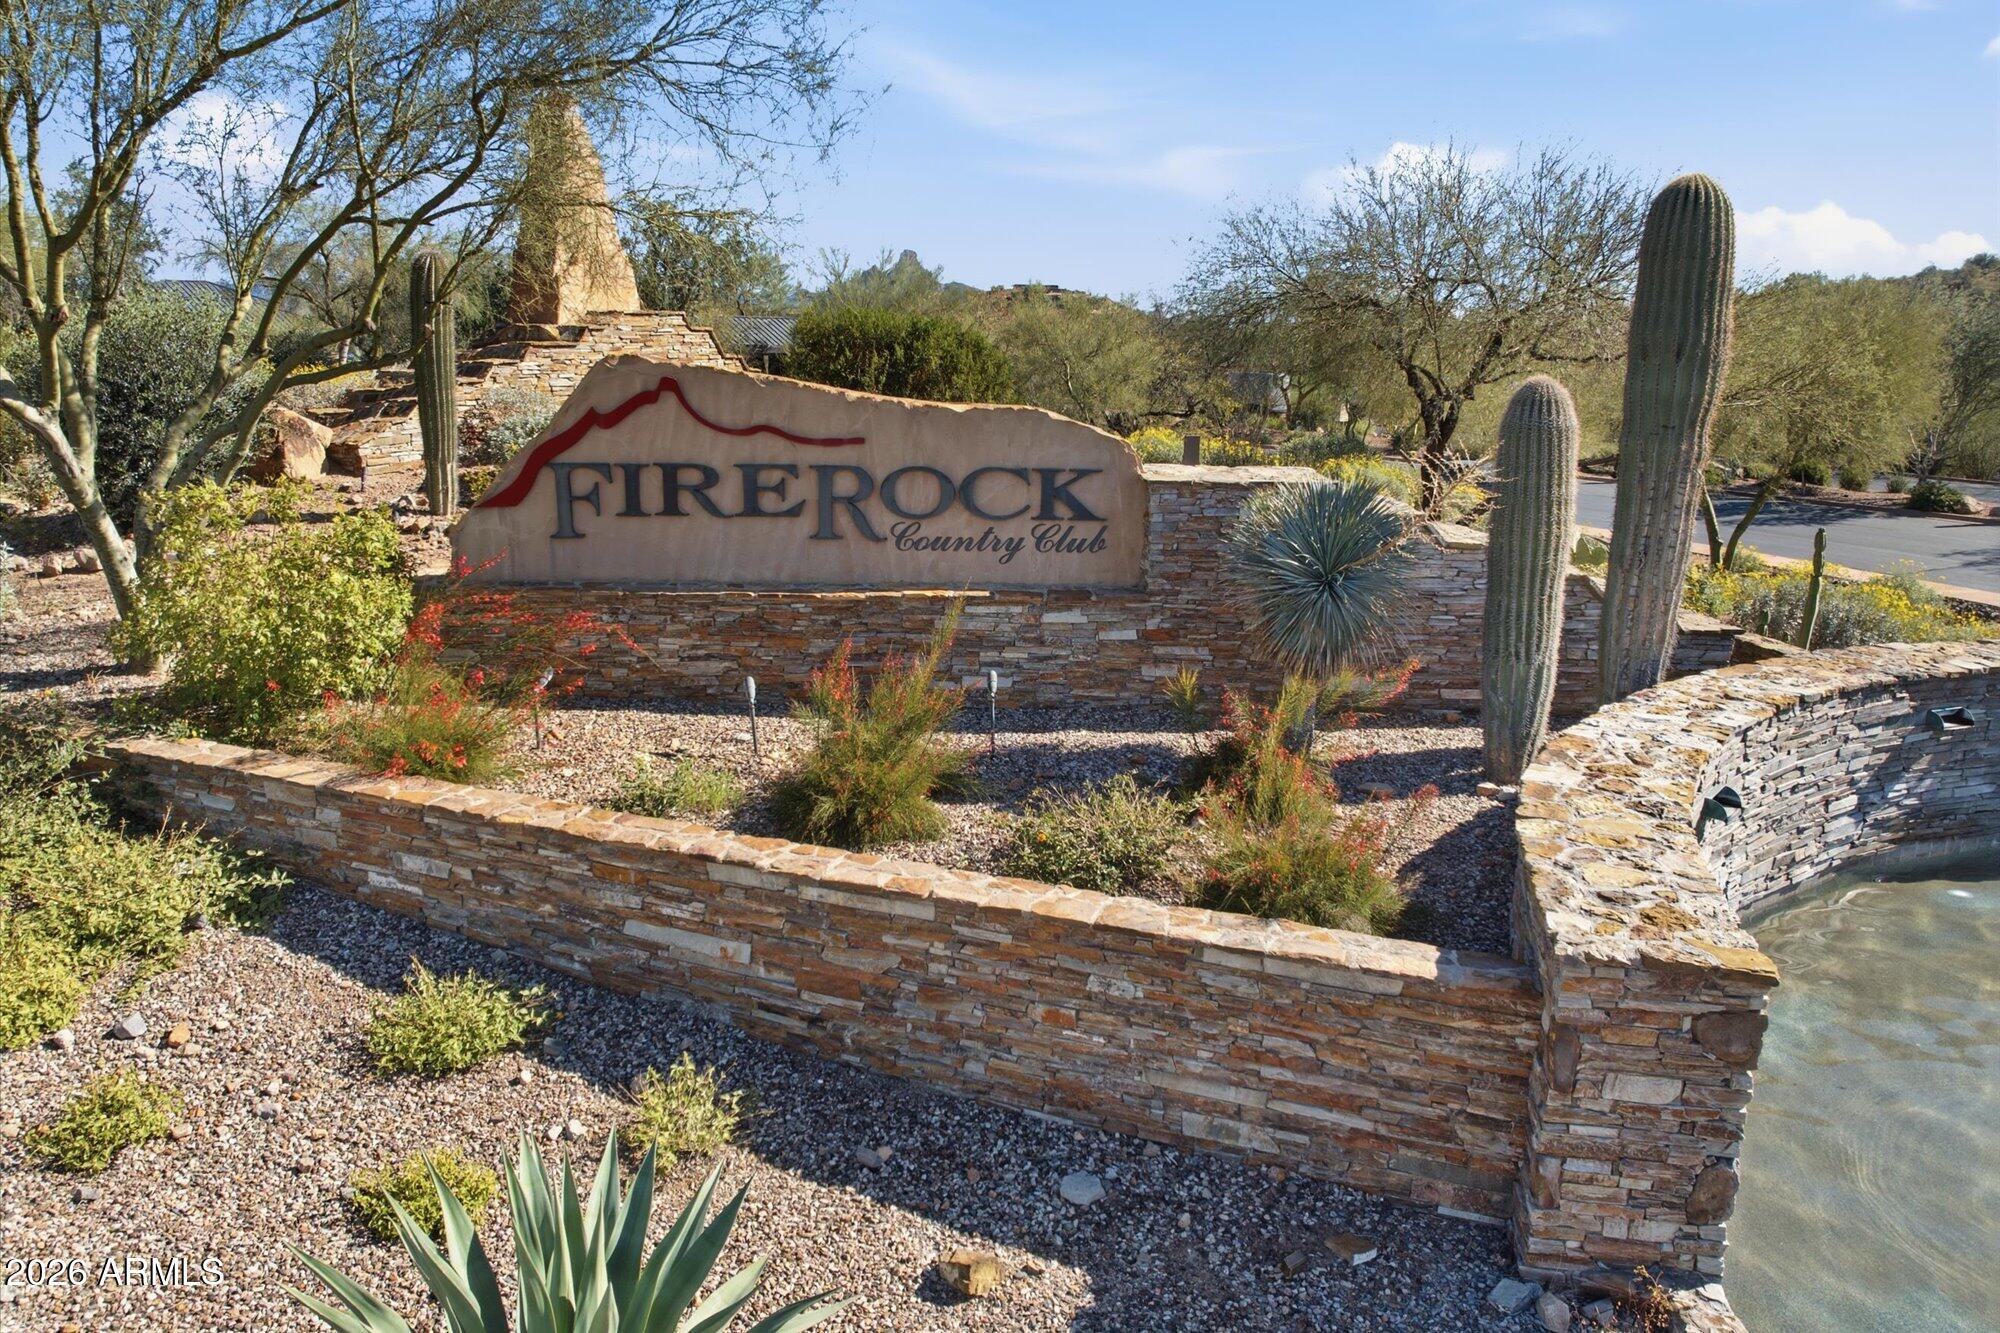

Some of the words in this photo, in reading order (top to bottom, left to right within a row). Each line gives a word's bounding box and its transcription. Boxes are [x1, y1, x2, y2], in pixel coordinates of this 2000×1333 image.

[549, 462, 1107, 541] FIREROCK
[889, 520, 1029, 565] Country
[1031, 521, 1107, 554] Club
